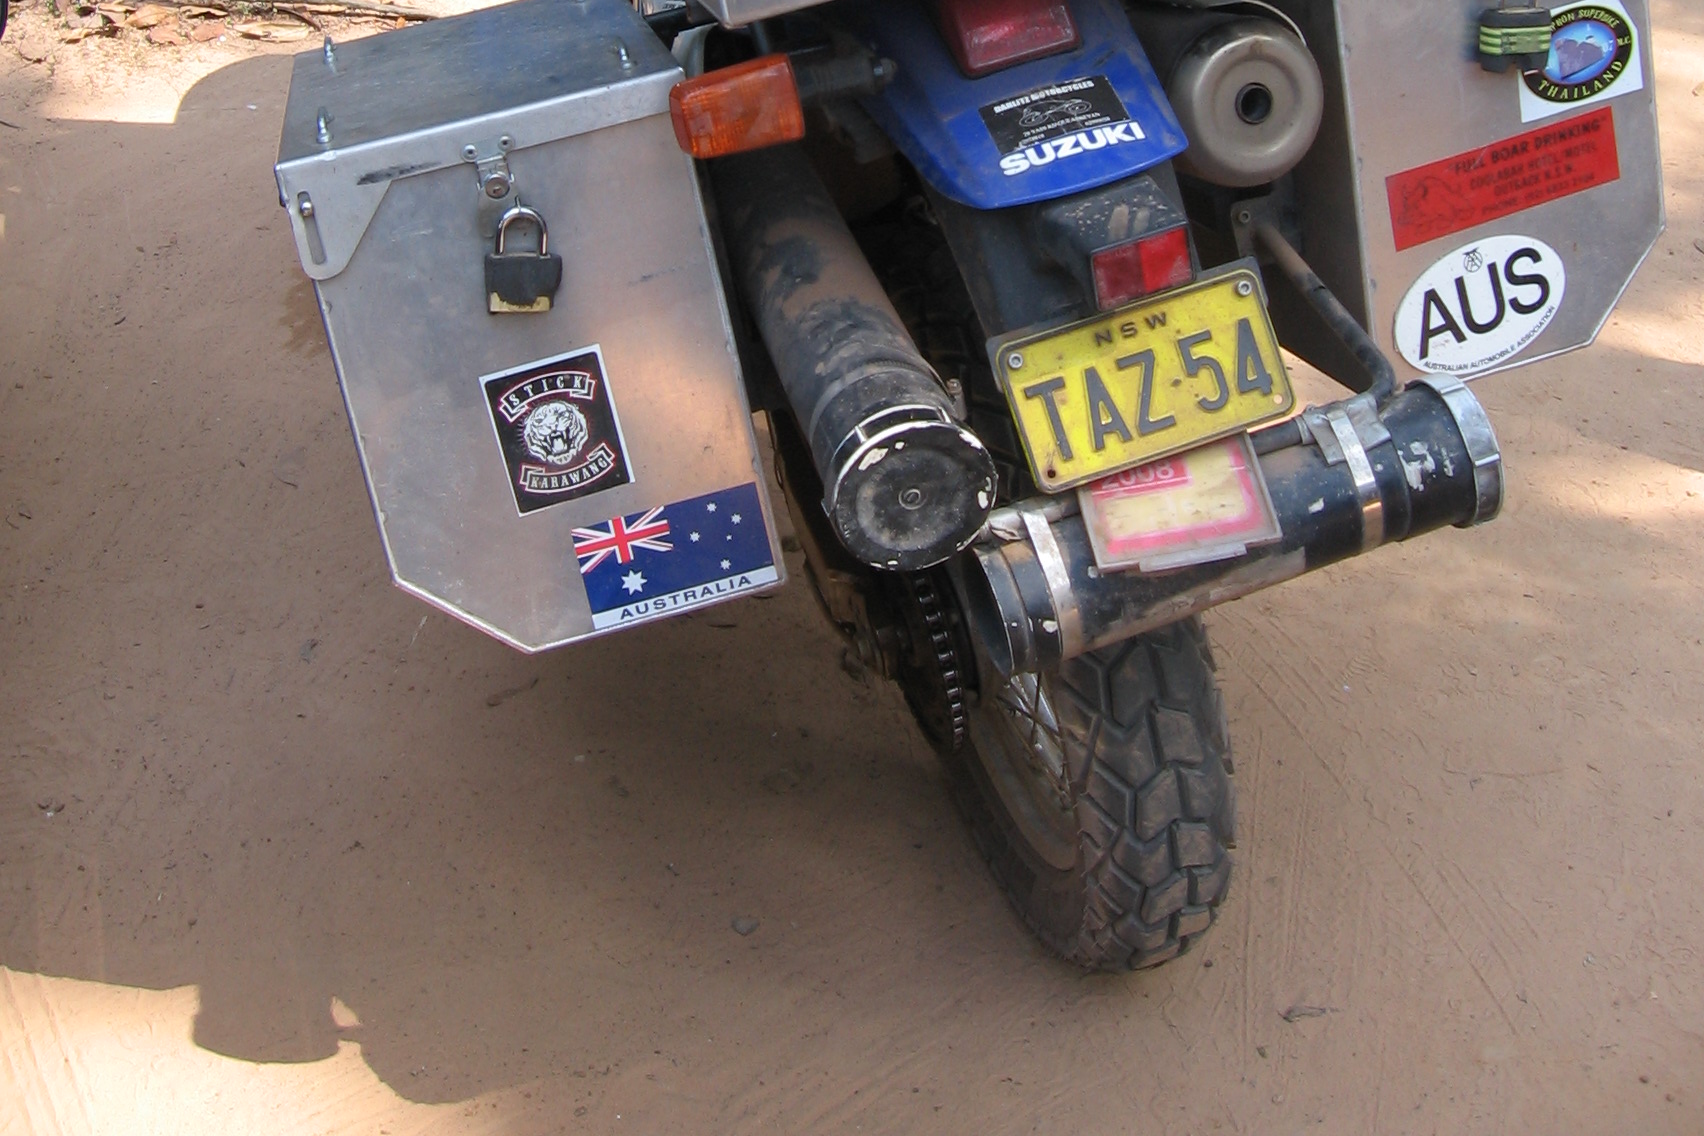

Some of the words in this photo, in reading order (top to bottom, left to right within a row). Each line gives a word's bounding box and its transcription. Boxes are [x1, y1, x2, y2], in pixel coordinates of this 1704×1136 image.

[1537, 59, 1624, 101] THAILAND
[999, 121, 1146, 176] SUZUKI
[1491, 140, 1530, 164] BOAR
[1419, 246, 1551, 361] AUS
[1094, 311, 1169, 348] NSW
[1422, 360, 1470, 372] AUSTRALIAN
[1469, 345, 1517, 370] AUTOMOBILE
[1516, 305, 1556, 348] ASSOCIATION
[508, 374, 583, 406] STICK
[530, 457, 609, 489] KARAWANG
[619, 574, 752, 620] AUSTRALIA
